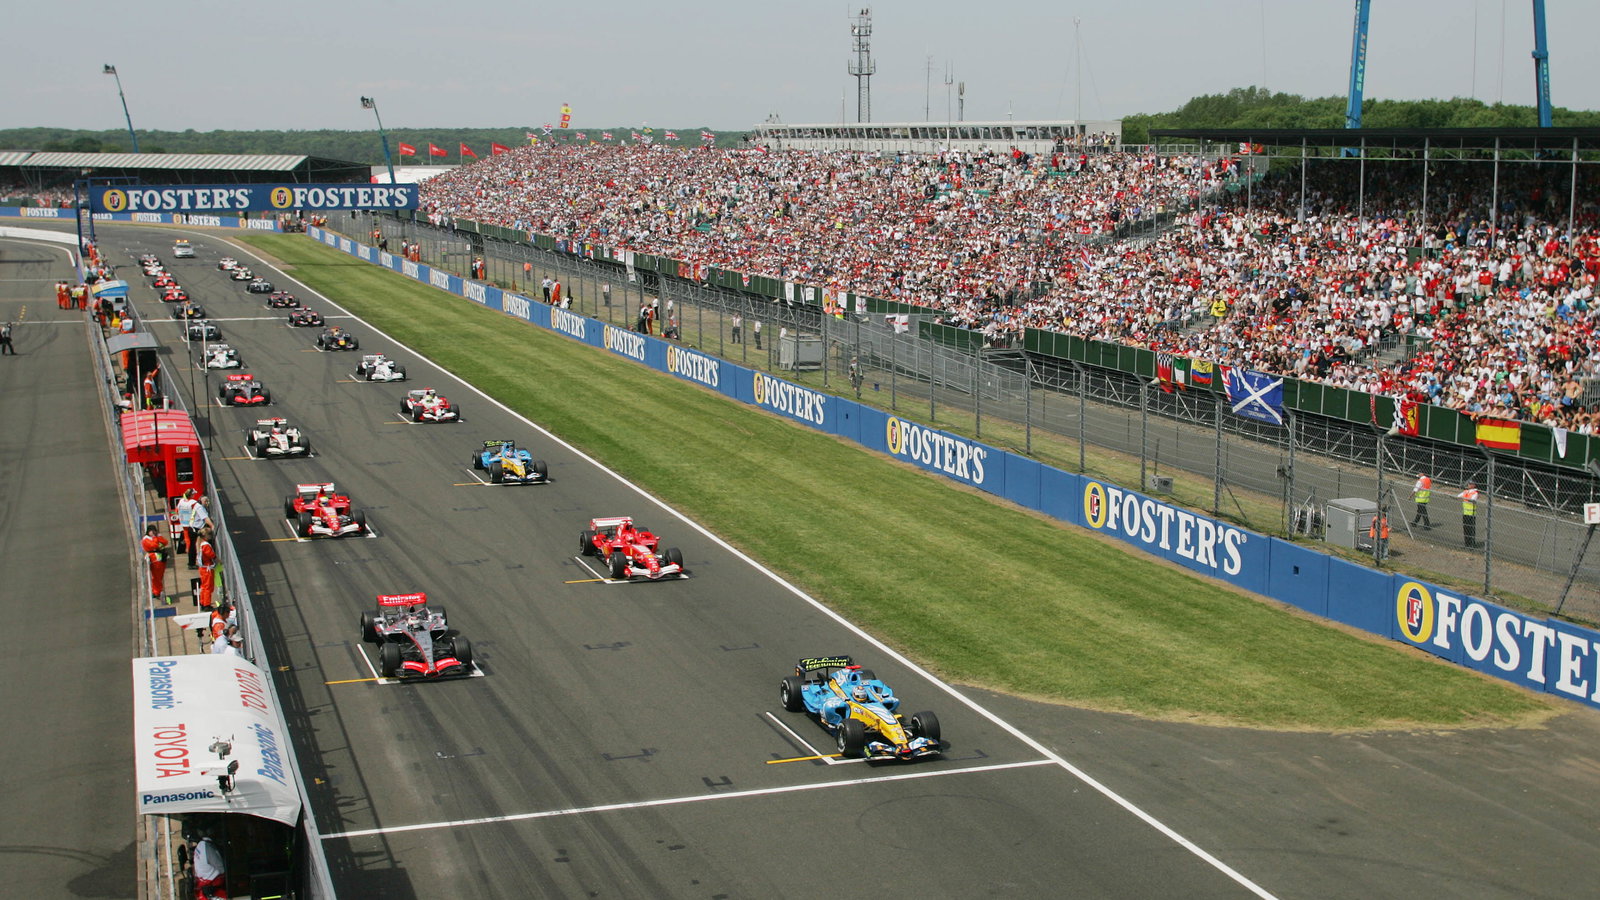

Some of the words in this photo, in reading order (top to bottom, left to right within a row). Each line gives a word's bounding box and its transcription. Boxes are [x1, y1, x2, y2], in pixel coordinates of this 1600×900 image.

[126, 188, 250, 210] FOSTER'S
[293, 187, 408, 208] FOSTER'S
[555, 309, 586, 339] FOSTER'S
[609, 326, 645, 361] FOSTER'S
[674, 348, 719, 387] FOSTER'S
[763, 376, 824, 425] FOSTER'S
[900, 420, 984, 484] FOSTER'S
[1106, 487, 1242, 576] FOSTER'S
[149, 660, 182, 710] Panasonic
[234, 668, 269, 715] TOYOTA
[153, 723, 190, 779] TOYOTA
[247, 723, 287, 787] Panasonic
[143, 788, 214, 805] Panasonic
